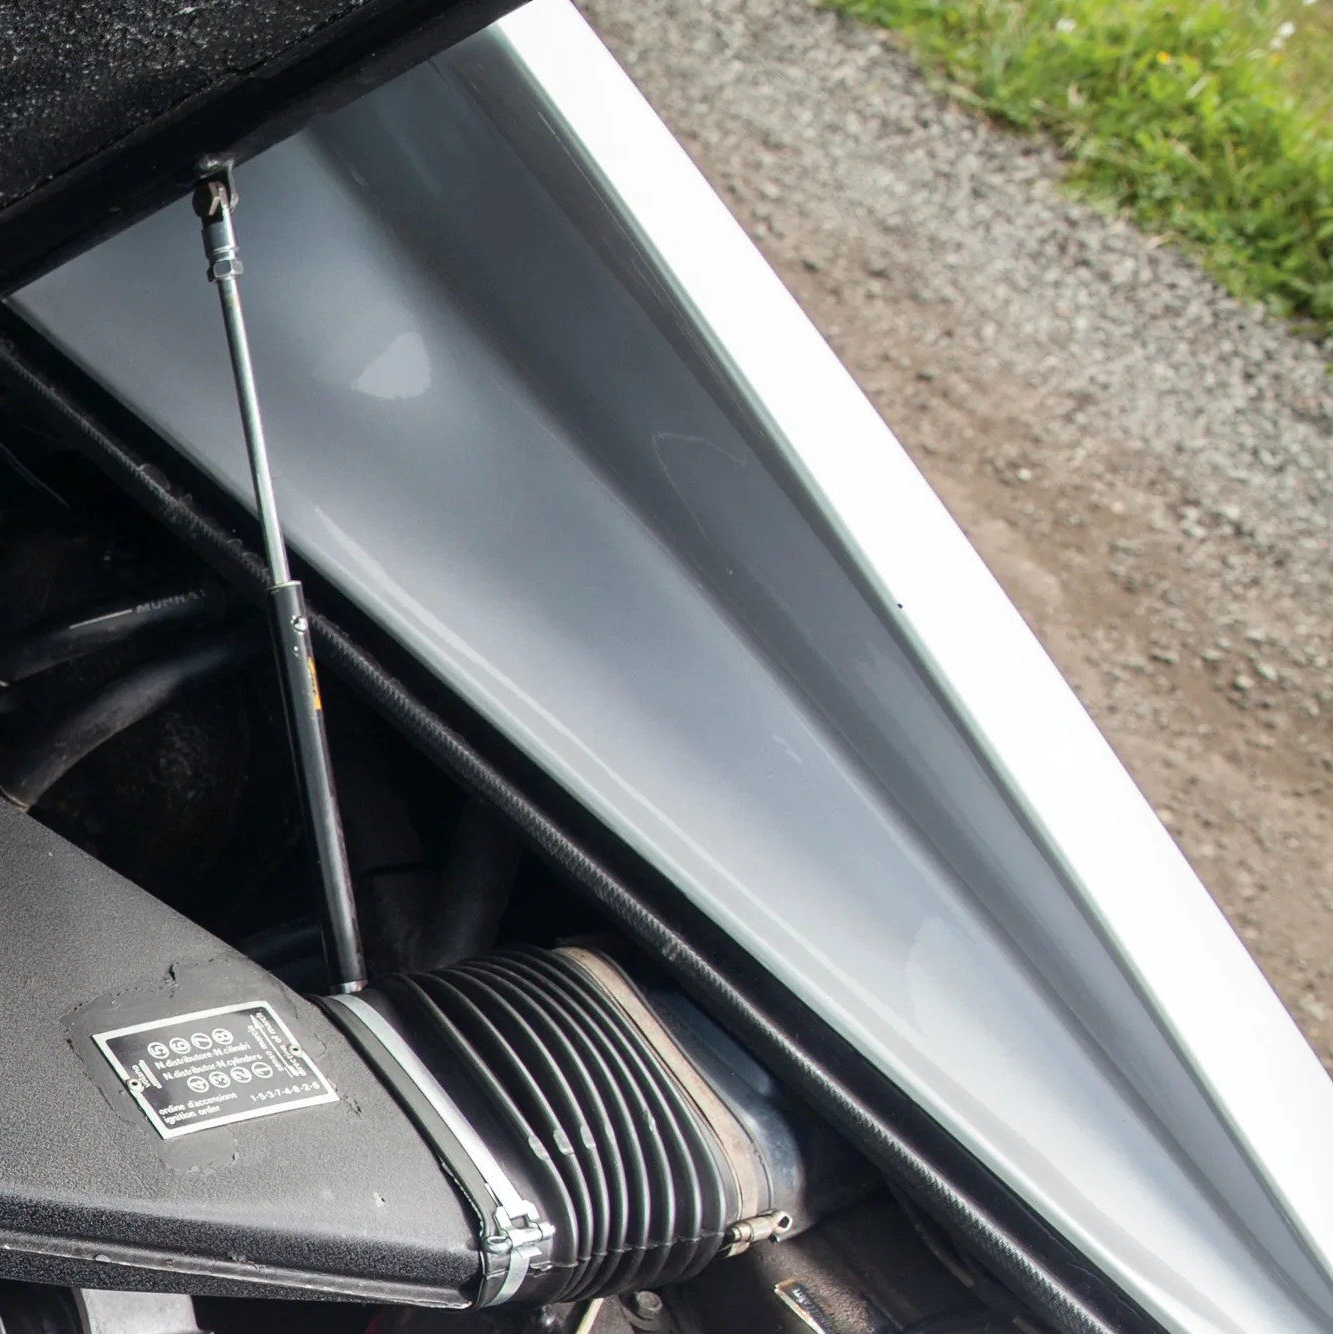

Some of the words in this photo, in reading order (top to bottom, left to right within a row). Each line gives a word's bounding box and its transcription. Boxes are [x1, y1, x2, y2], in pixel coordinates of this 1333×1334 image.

[159, 1102, 186, 1115] ordine
[164, 1110, 196, 1124] ignition
[198, 1105, 221, 1118] order
